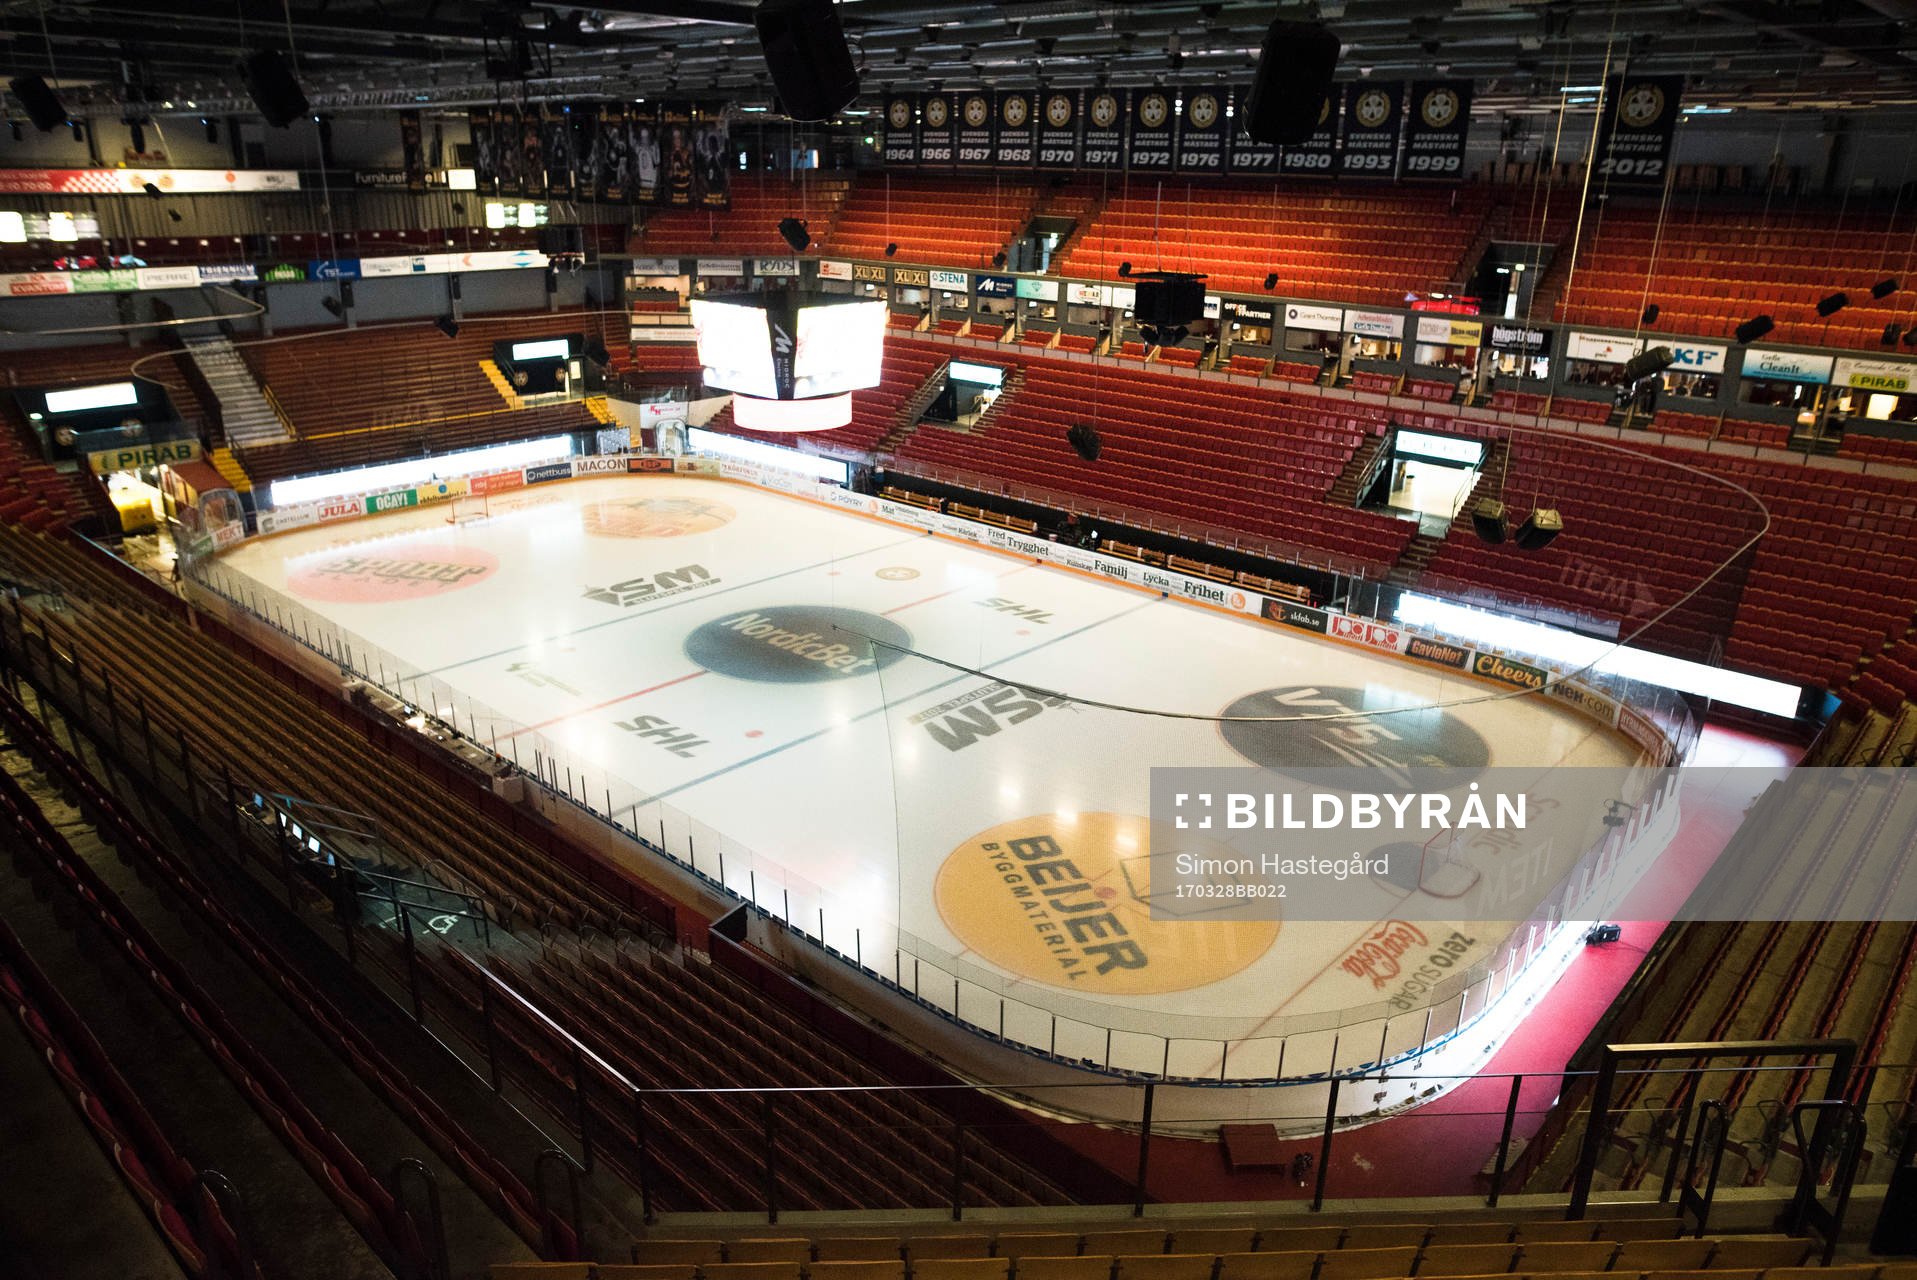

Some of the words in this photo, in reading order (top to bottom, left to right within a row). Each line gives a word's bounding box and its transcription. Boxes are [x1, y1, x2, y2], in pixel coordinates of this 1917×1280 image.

[886, 148, 914, 160] 1964
[921, 148, 951, 159] 1966
[959, 149, 991, 160] 1967
[998, 149, 1031, 161] 1968
[1040, 150, 1074, 162] 1970
[1085, 150, 1118, 163] 1971
[1132, 152, 1170, 164] 1972
[1181, 153, 1219, 166] 1976
[1232, 153, 1274, 167] 1977
[1285, 154, 1332, 168] 1980
[1344, 154, 1392, 168] 1993
[1408, 155, 1460, 170] 1999
[1598, 158, 1663, 176] 2012
[856, 267, 868, 278] XL
[871, 268, 884, 280] XL
[896, 271, 910, 282] XL
[914, 272, 927, 284] XL
[939, 272, 965, 284] STENA
[1224, 302, 1247, 311] OFFICE
[1674, 348, 1719, 366] KF
[1860, 375, 1907, 389] PIRAB
[117, 444, 192, 468] PIRAB
[577, 458, 627, 472] MACON
[320, 502, 359, 520] JULA
[988, 528, 1006, 540] Fred
[1008, 537, 1050, 556] Trygghet
[1094, 559, 1128, 579] Familj
[1143, 571, 1170, 587] Lycka
[1183, 580, 1225, 603] Frihet
[1290, 610, 1320, 627] skfab.se
[721, 612, 876, 675] NordicBet
[1476, 654, 1542, 688] Cheers
[924, 688, 1044, 752] SM
[612, 714, 711, 758] SHL
[981, 841, 1087, 981] BYGGMATERIAL
[1007, 835, 1148, 976] BEIJER
[1430, 931, 1477, 968] zero
[1390, 964, 1443, 1011] SUGAR
